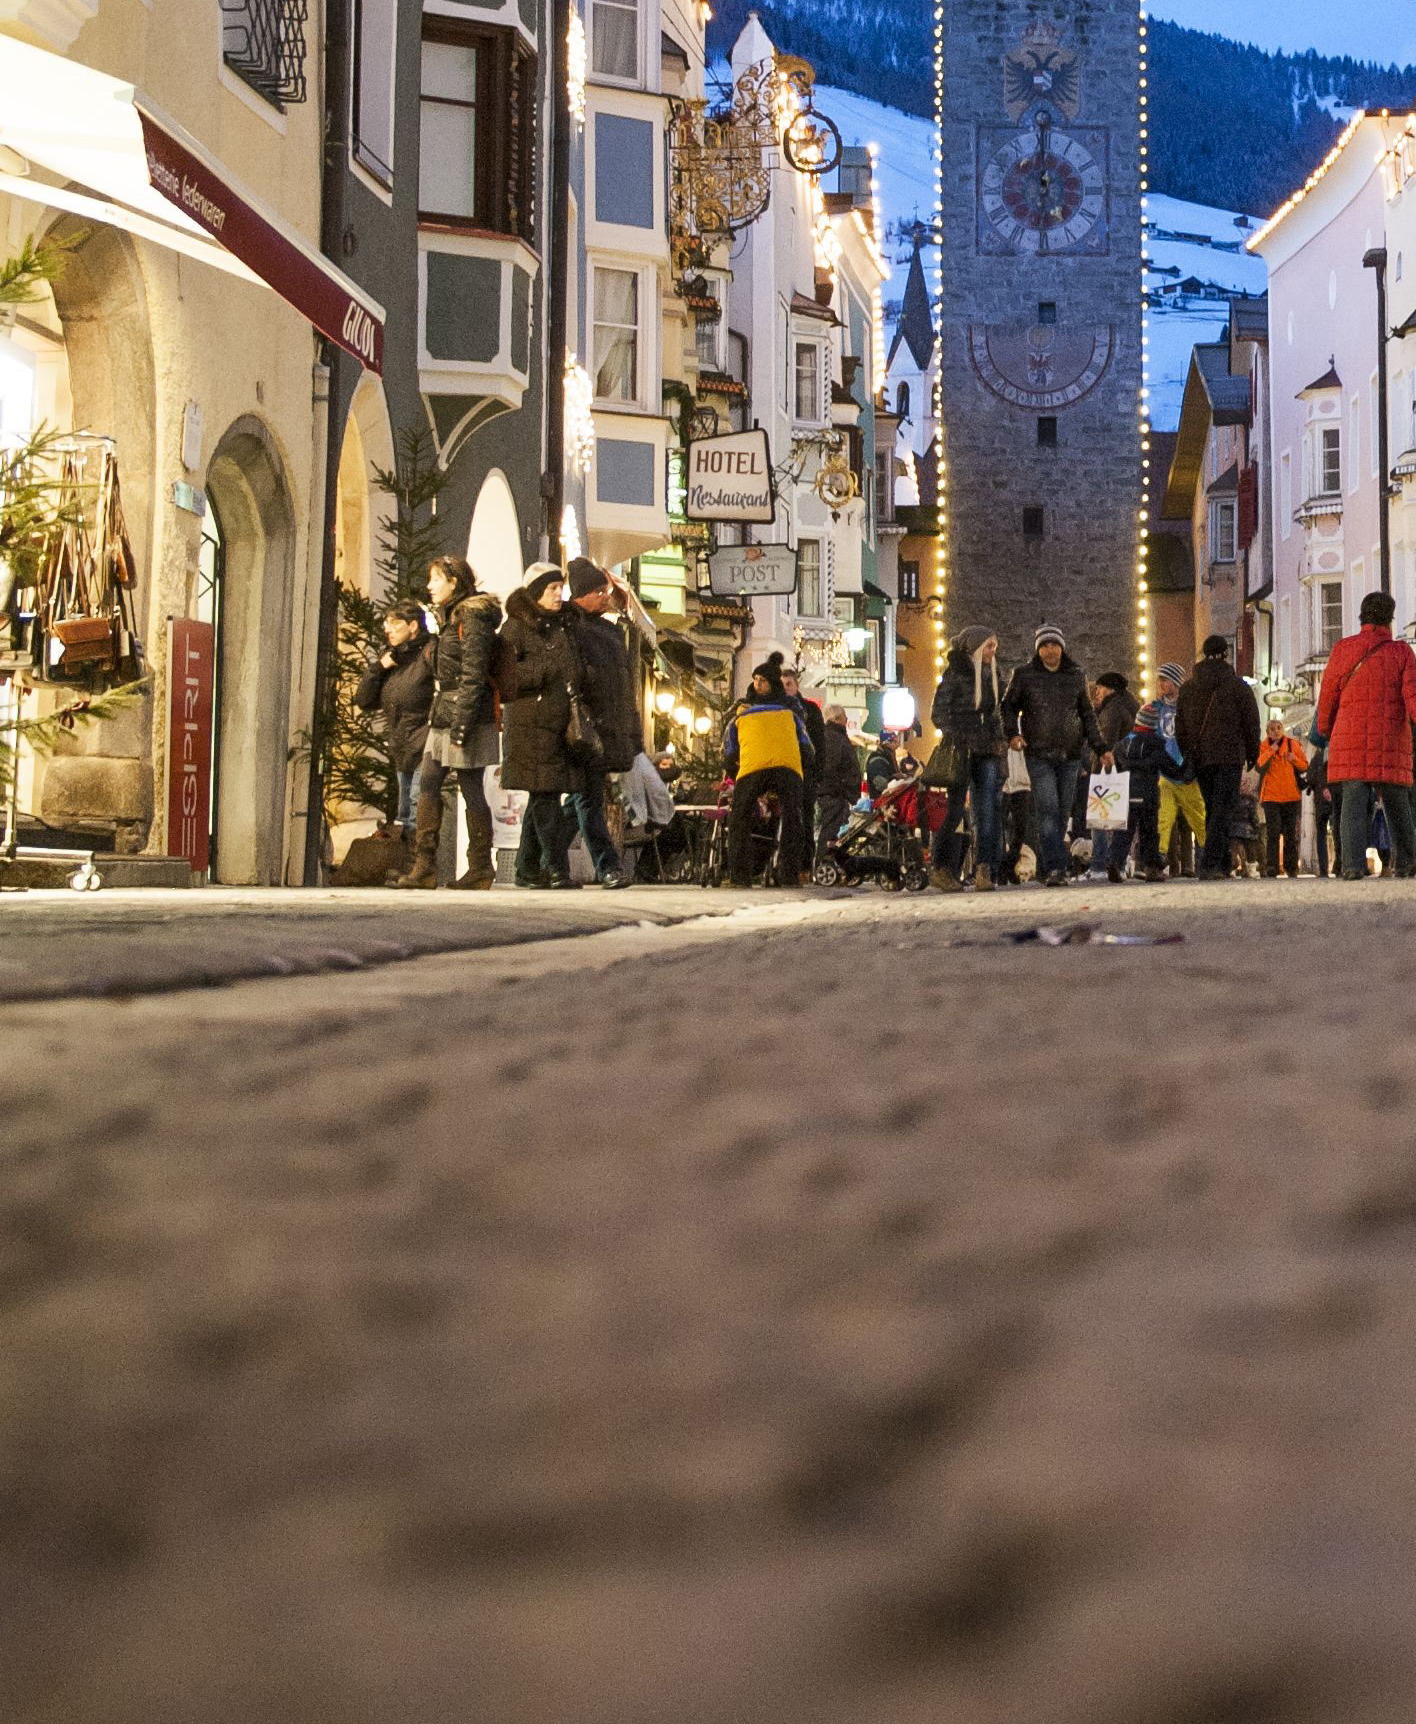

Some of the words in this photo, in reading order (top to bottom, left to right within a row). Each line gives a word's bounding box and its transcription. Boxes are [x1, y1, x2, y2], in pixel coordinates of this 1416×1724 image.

[182, 175, 226, 231] lederwaren
[695, 449, 764, 475] HOTEL
[689, 484, 770, 510] Restaurant
[728, 563, 781, 584] POST
[181, 632, 200, 857] ESPRIT
